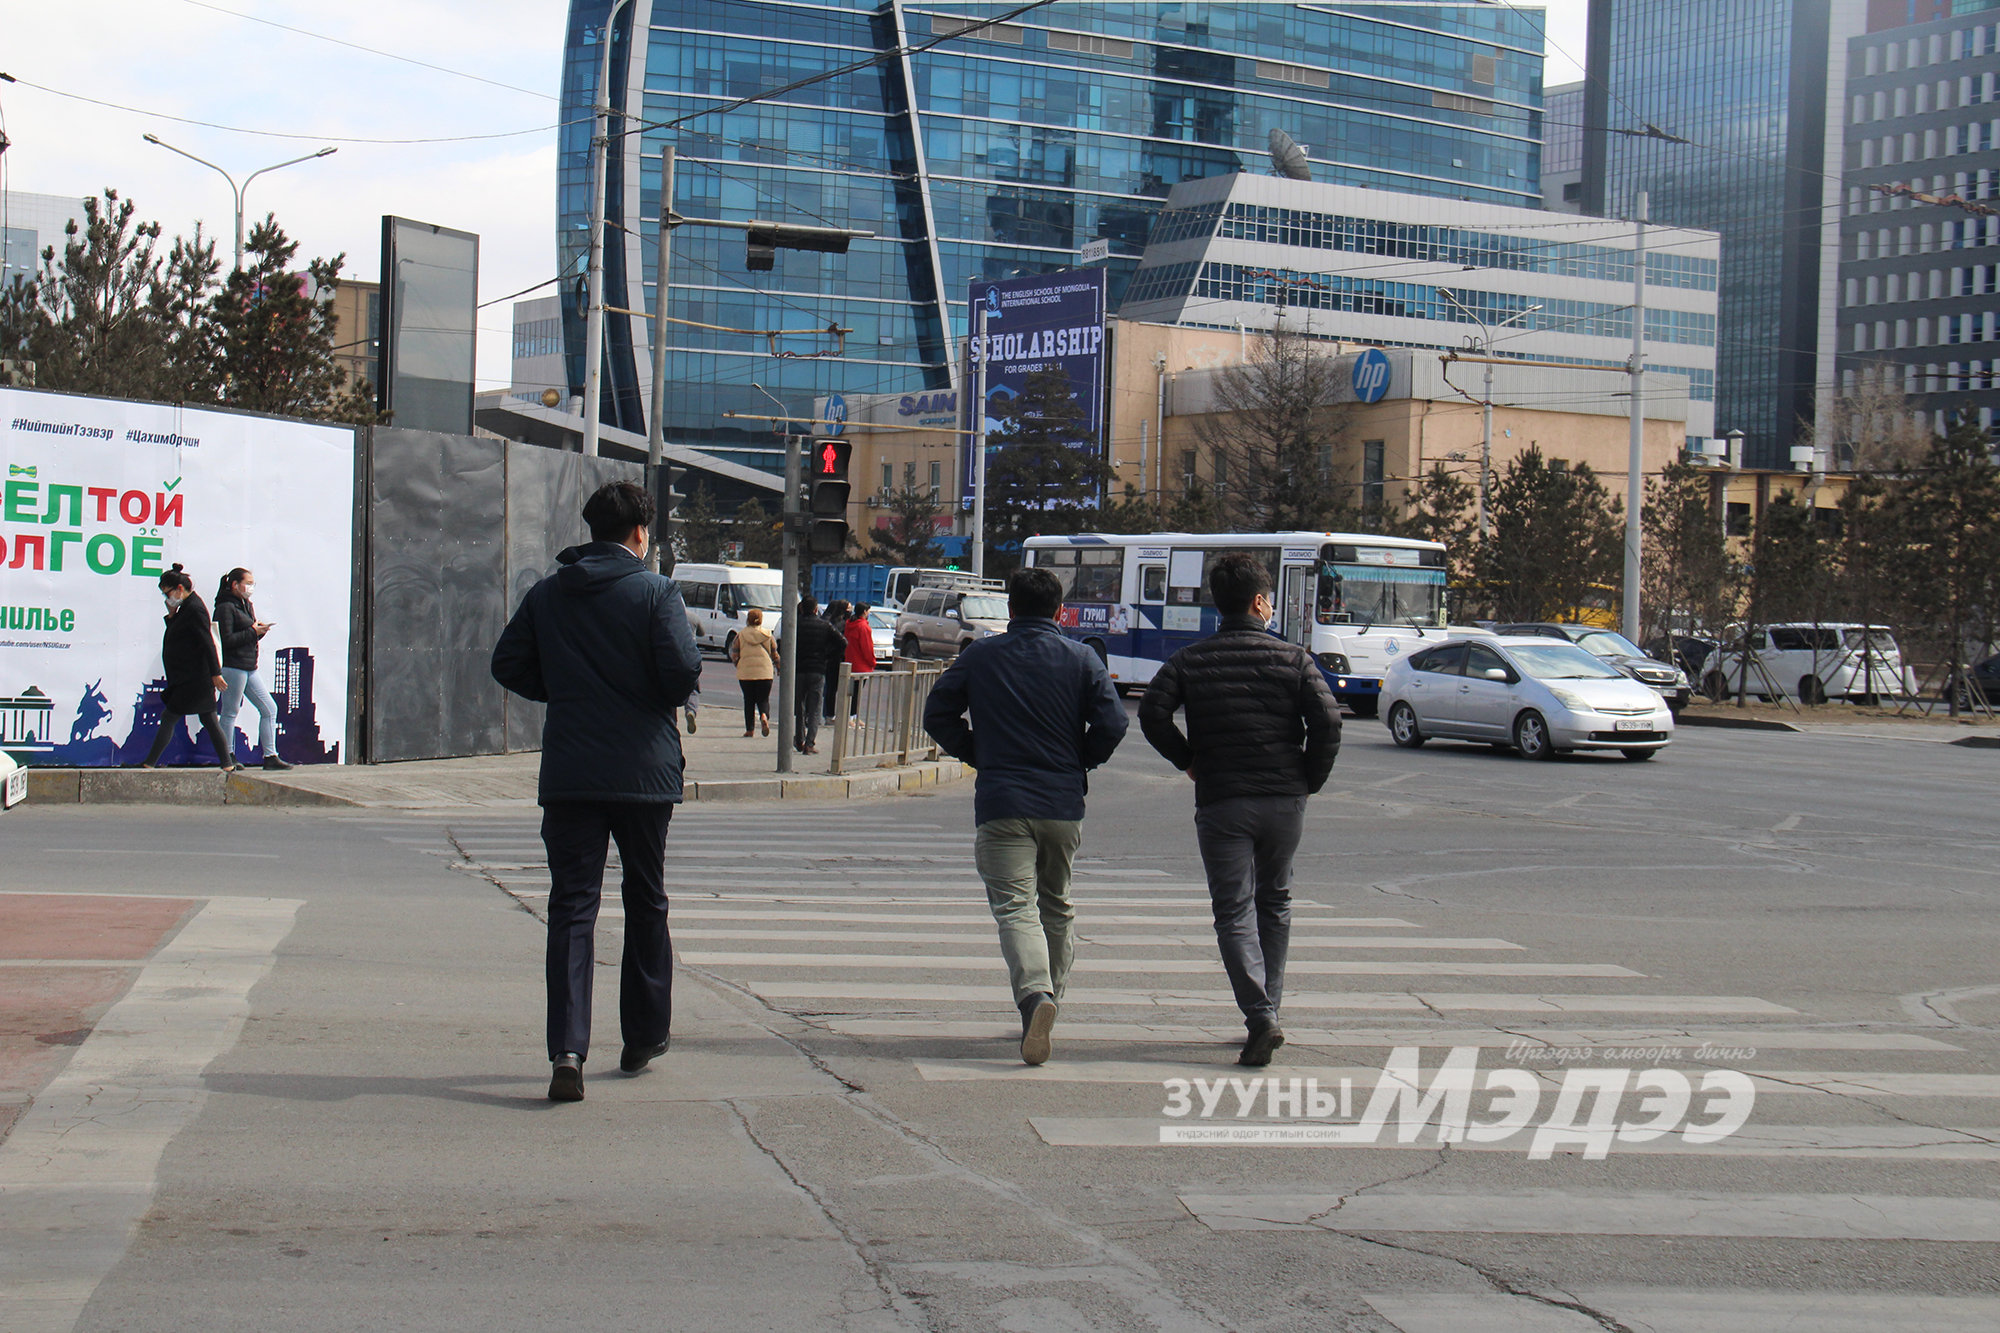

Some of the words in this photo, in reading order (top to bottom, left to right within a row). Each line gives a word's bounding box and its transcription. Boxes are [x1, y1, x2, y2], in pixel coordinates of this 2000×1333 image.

[1001, 291, 1011, 300] THE
[1012, 288, 1033, 299] ENGLISH
[1034, 287, 1053, 297] SCHOOL
[1054, 286, 1062, 295] OF
[1062, 283, 1090, 294] MONGOLIA
[1001, 297, 1040, 308] INTERNATIONAL
[1041, 294, 1061, 304] SCHOOL
[1004, 365, 1017, 374] FOR
[1018, 363, 1043, 373] GRADES
[1355, 348, 1386, 403] hp
[898, 392, 957, 416] SAIN
[11, 418, 114, 441] #НийтийнТээвэр
[126, 429, 200, 448] #ЦахимОрчин
[0, 464, 184, 527] ЁЛТОЙ
[0, 527, 164, 577] ЛГОЁ
[1083, 607, 1106, 622] ГУРИЛ
